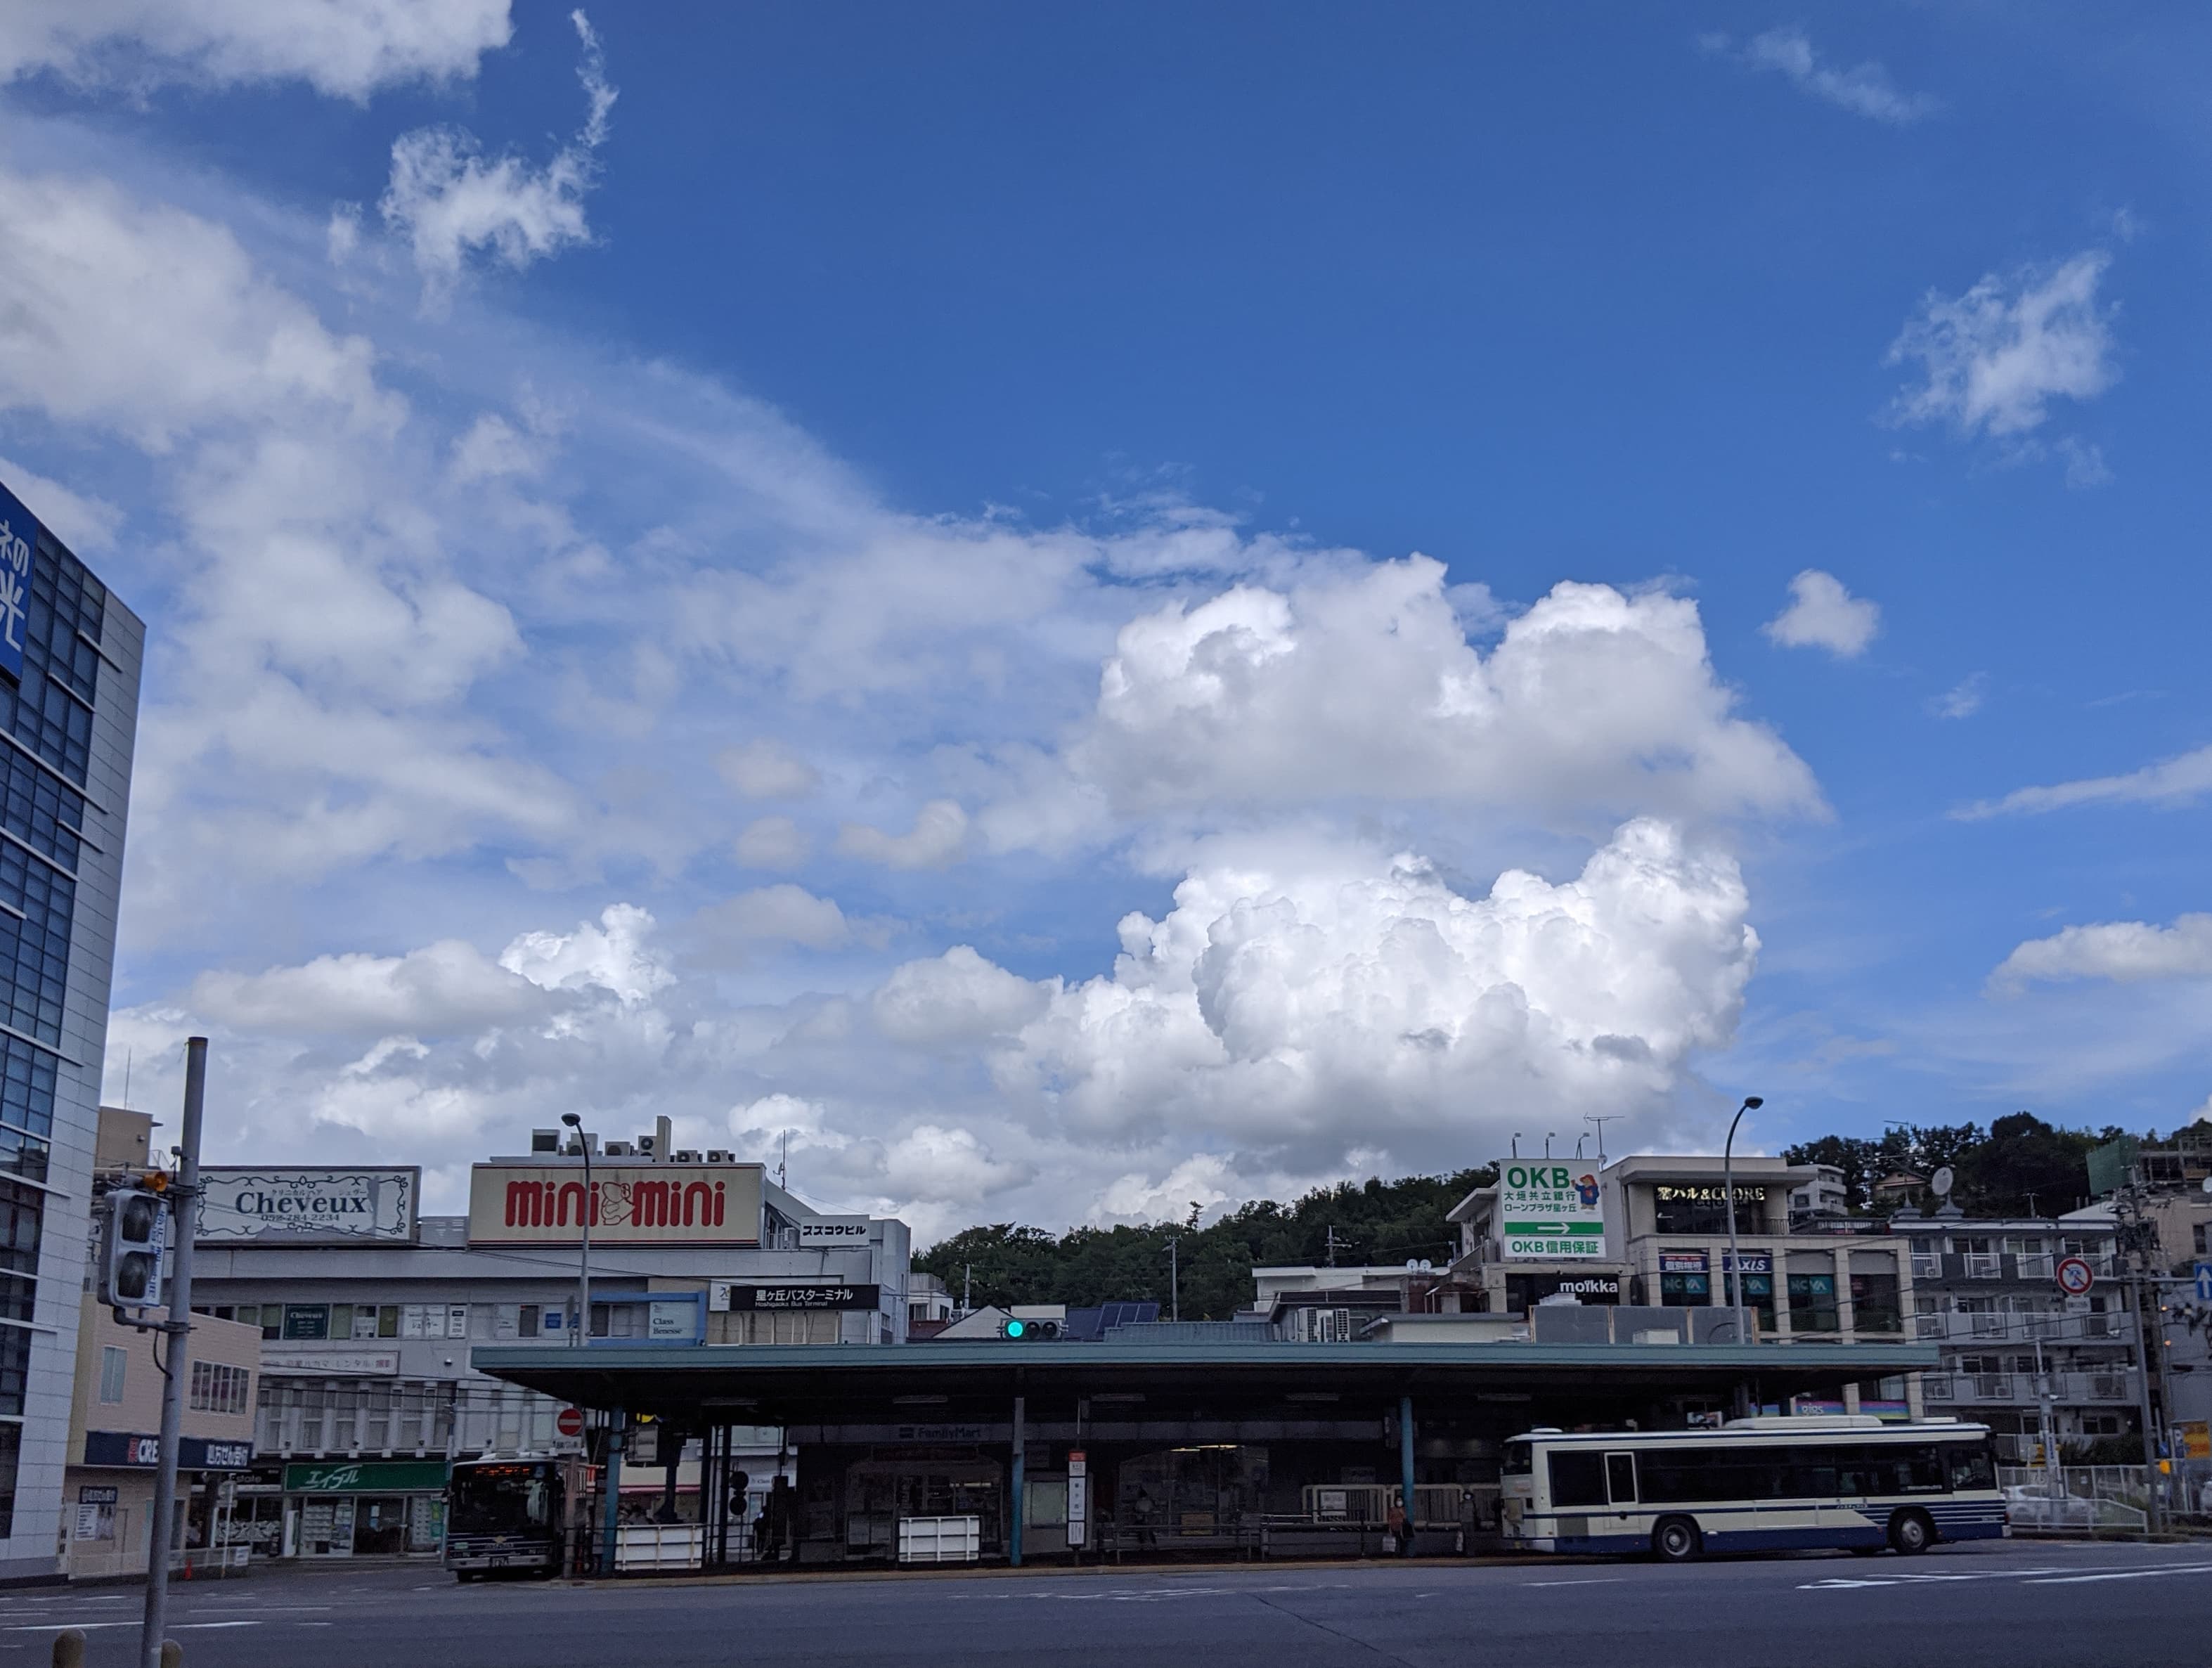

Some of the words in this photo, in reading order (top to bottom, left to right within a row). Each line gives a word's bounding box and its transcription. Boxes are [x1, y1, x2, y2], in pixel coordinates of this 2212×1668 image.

[1508, 1168, 1570, 1189] OKB
[1504, 1191, 1576, 1201] 大垣共立銀行
[235, 1192, 368, 1214] Cheveux
[505, 1181, 600, 1227] mini
[631, 1181, 725, 1227] mini
[803, 1225, 867, 1236] スズコウビル
[755, 1289, 853, 1302] 星ヶ丘バスターミナル
[919, 1428, 979, 1440] FamilyMart
